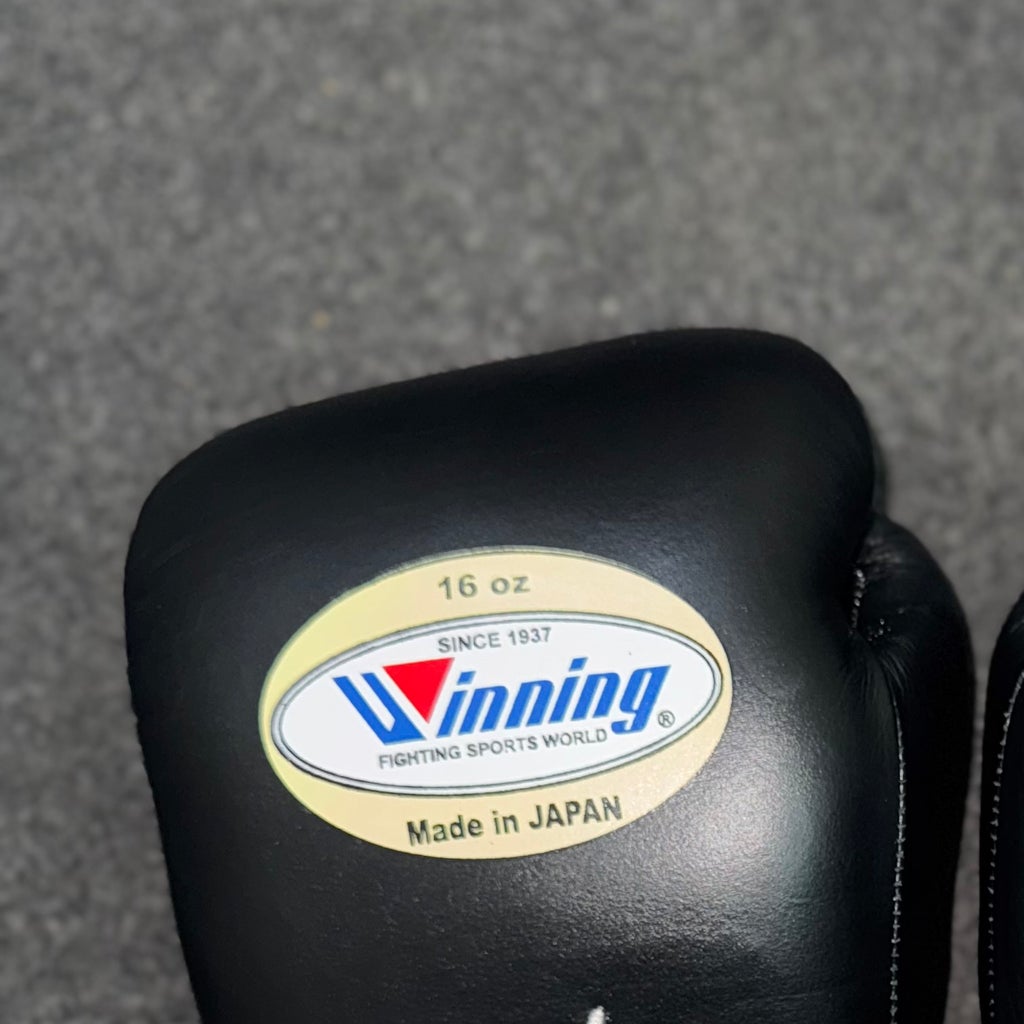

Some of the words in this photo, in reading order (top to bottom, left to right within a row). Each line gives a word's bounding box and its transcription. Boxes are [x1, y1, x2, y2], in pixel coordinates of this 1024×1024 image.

[438, 573, 478, 600] 16
[491, 575, 531, 596] oz
[437, 632, 501, 654] SINCE
[507, 627, 552, 647] 1937
[333, 657, 671, 746] Winning
[378, 745, 461, 770] FIGHTING
[467, 736, 538, 758] SPORTS
[544, 727, 608, 750] WORLD
[407, 816, 484, 846] Made
[493, 810, 520, 835] in
[529, 796, 623, 830] JAPAN
